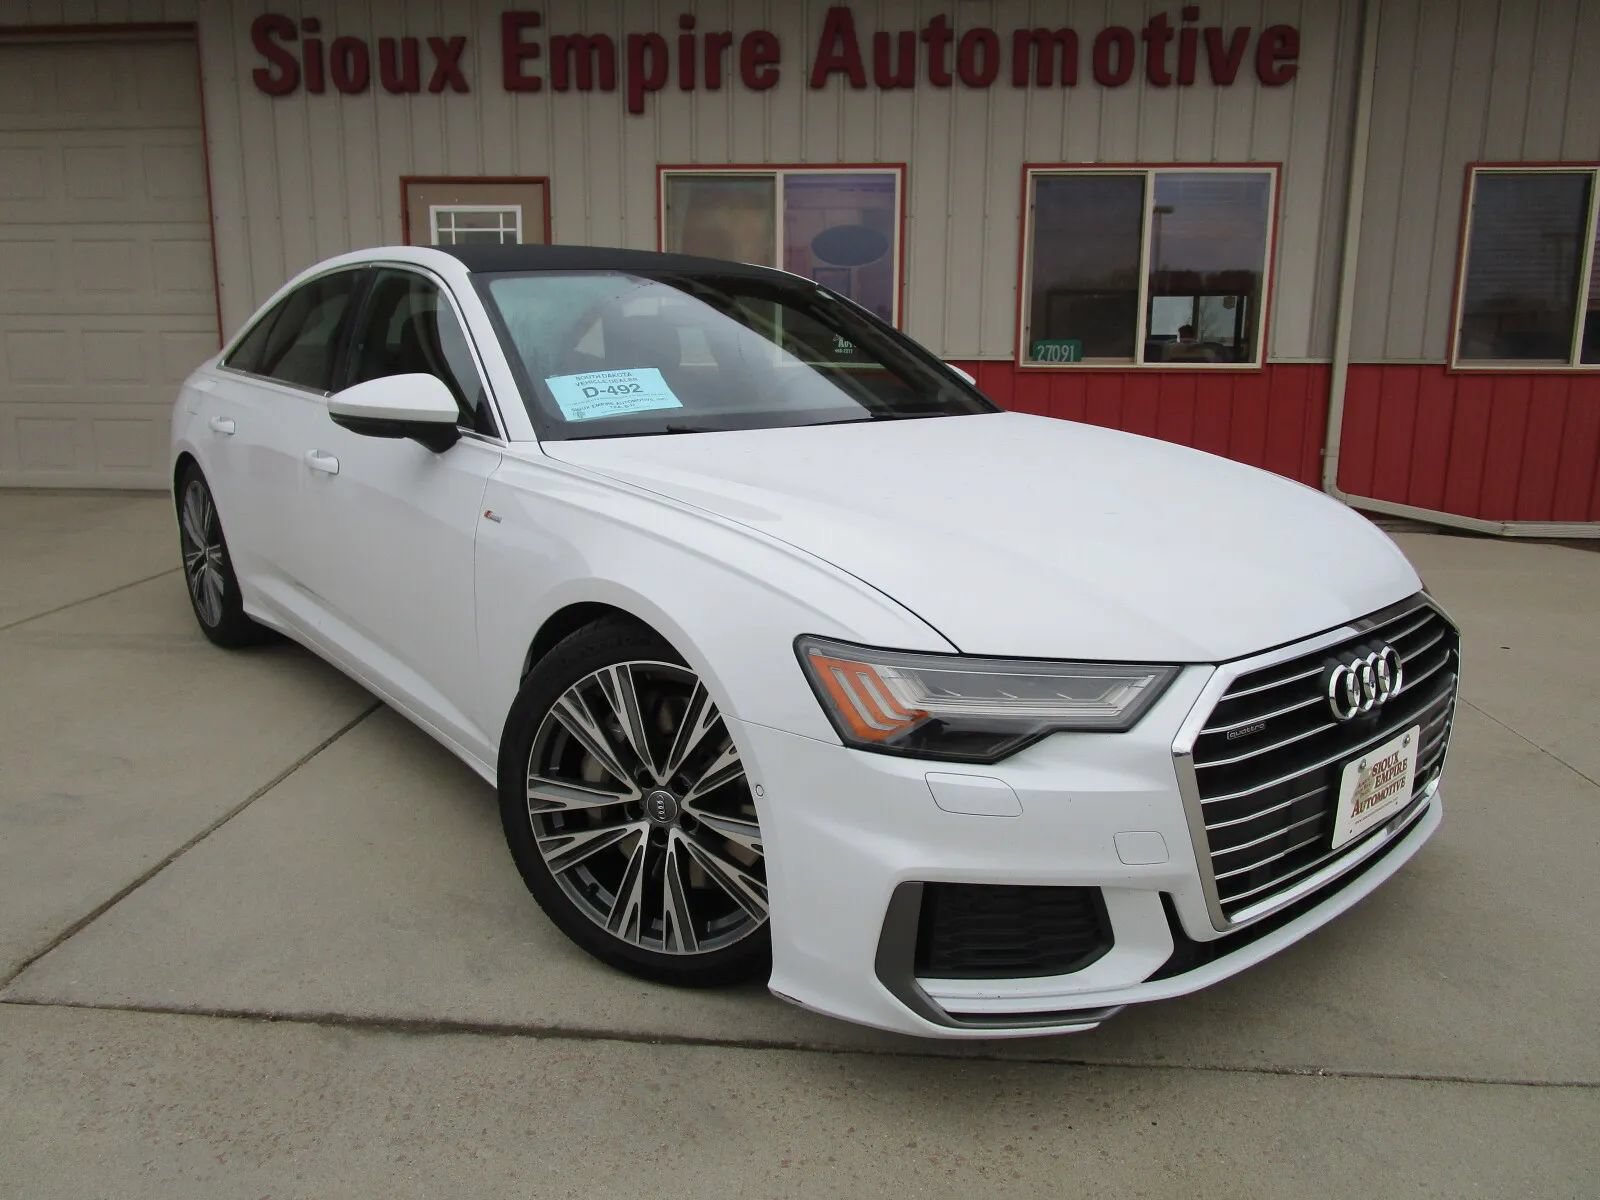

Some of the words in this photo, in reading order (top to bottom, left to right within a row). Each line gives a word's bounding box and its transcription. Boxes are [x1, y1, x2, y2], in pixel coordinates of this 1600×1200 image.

[250, 13, 470, 96] Sioux
[501, 10, 781, 115] Empire
[810, 5, 1299, 89] Automotive
[1037, 344, 1074, 362] 27091
[575, 373, 602, 381] SOUTH
[602, 371, 633, 379] DAKOTA
[582, 383, 644, 399] D-492
[1229, 722, 1265, 739] quattro
[1371, 751, 1399, 777] SIOUX
[1374, 758, 1408, 789] EMPIRE
[1351, 777, 1406, 818] AUTOMOTIVE
